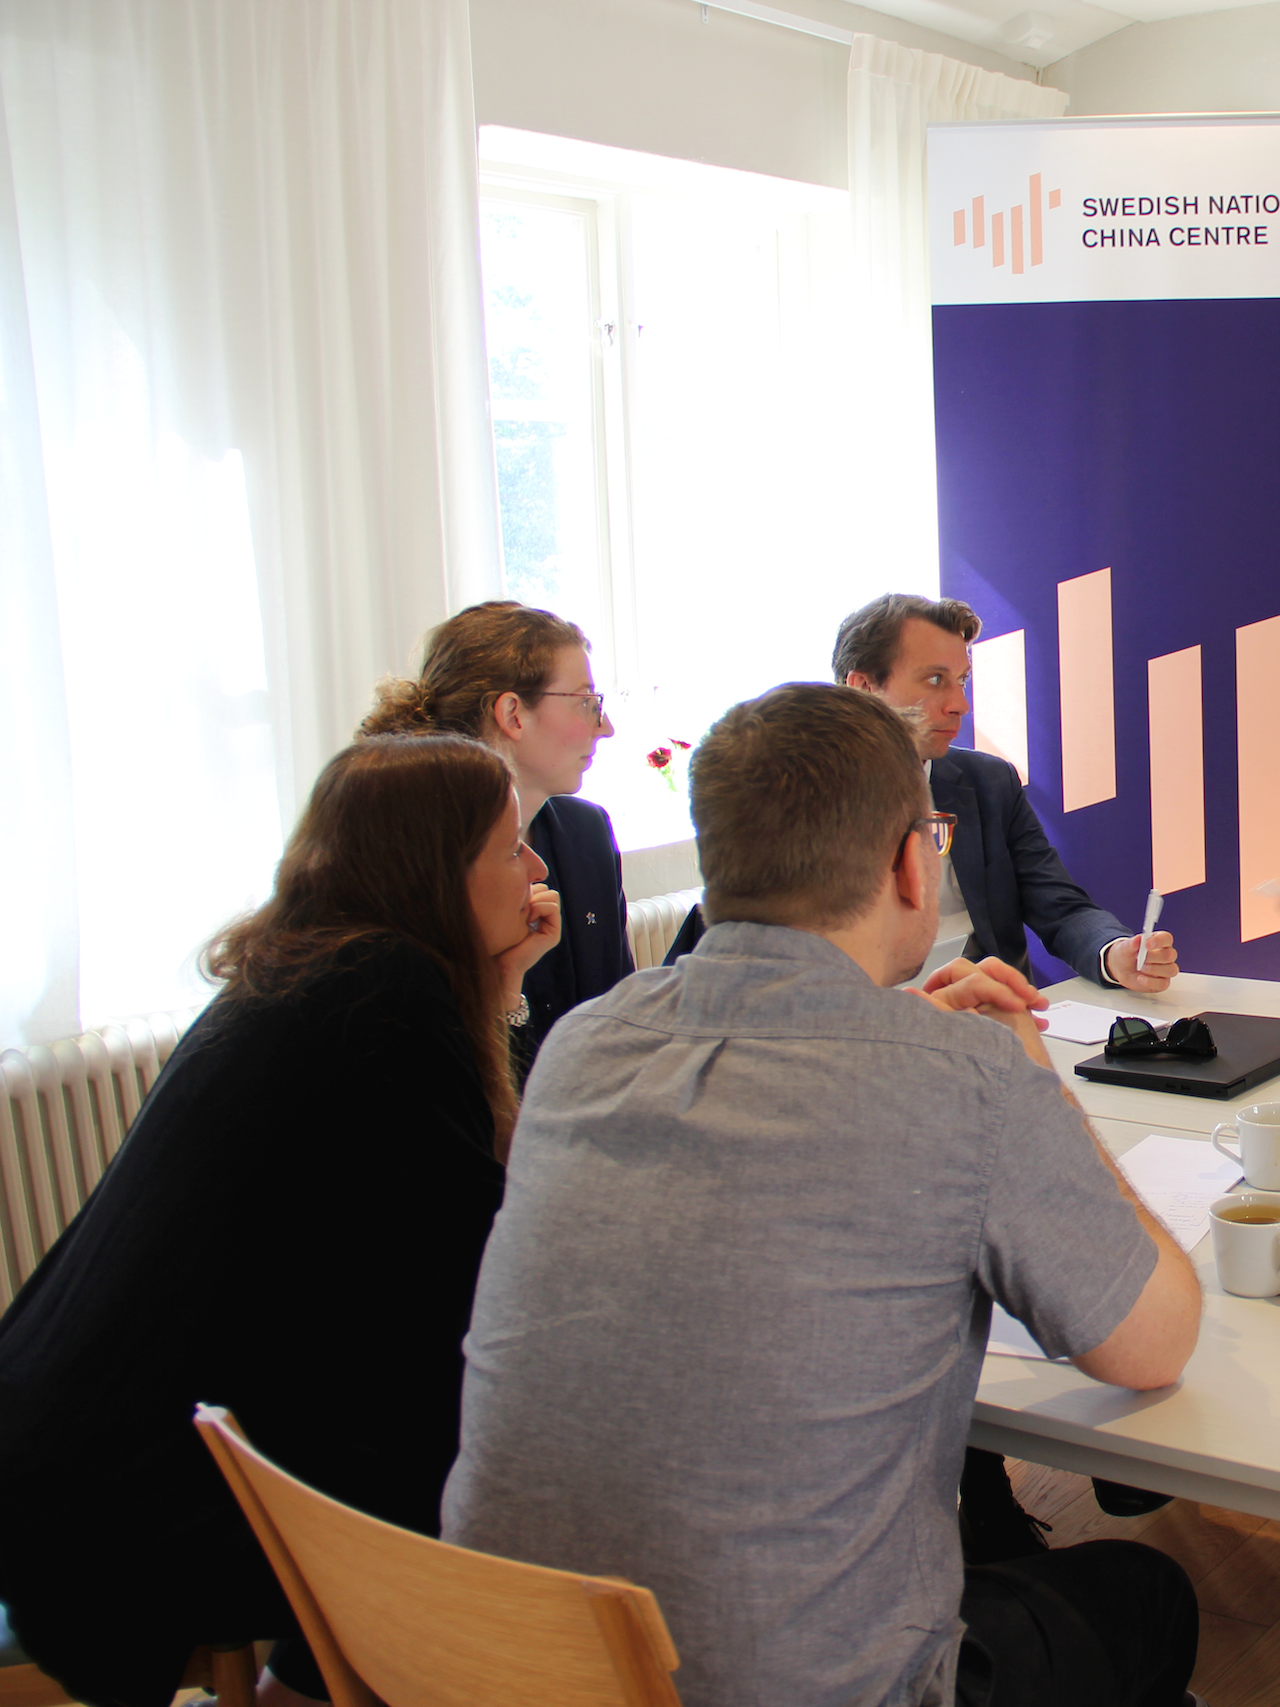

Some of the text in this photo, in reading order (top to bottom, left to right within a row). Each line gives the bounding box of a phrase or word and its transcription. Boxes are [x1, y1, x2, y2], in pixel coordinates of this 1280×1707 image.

[1082, 196, 1199, 218] SWEDISH
[1082, 226, 1269, 249] CHINA CENTRE
